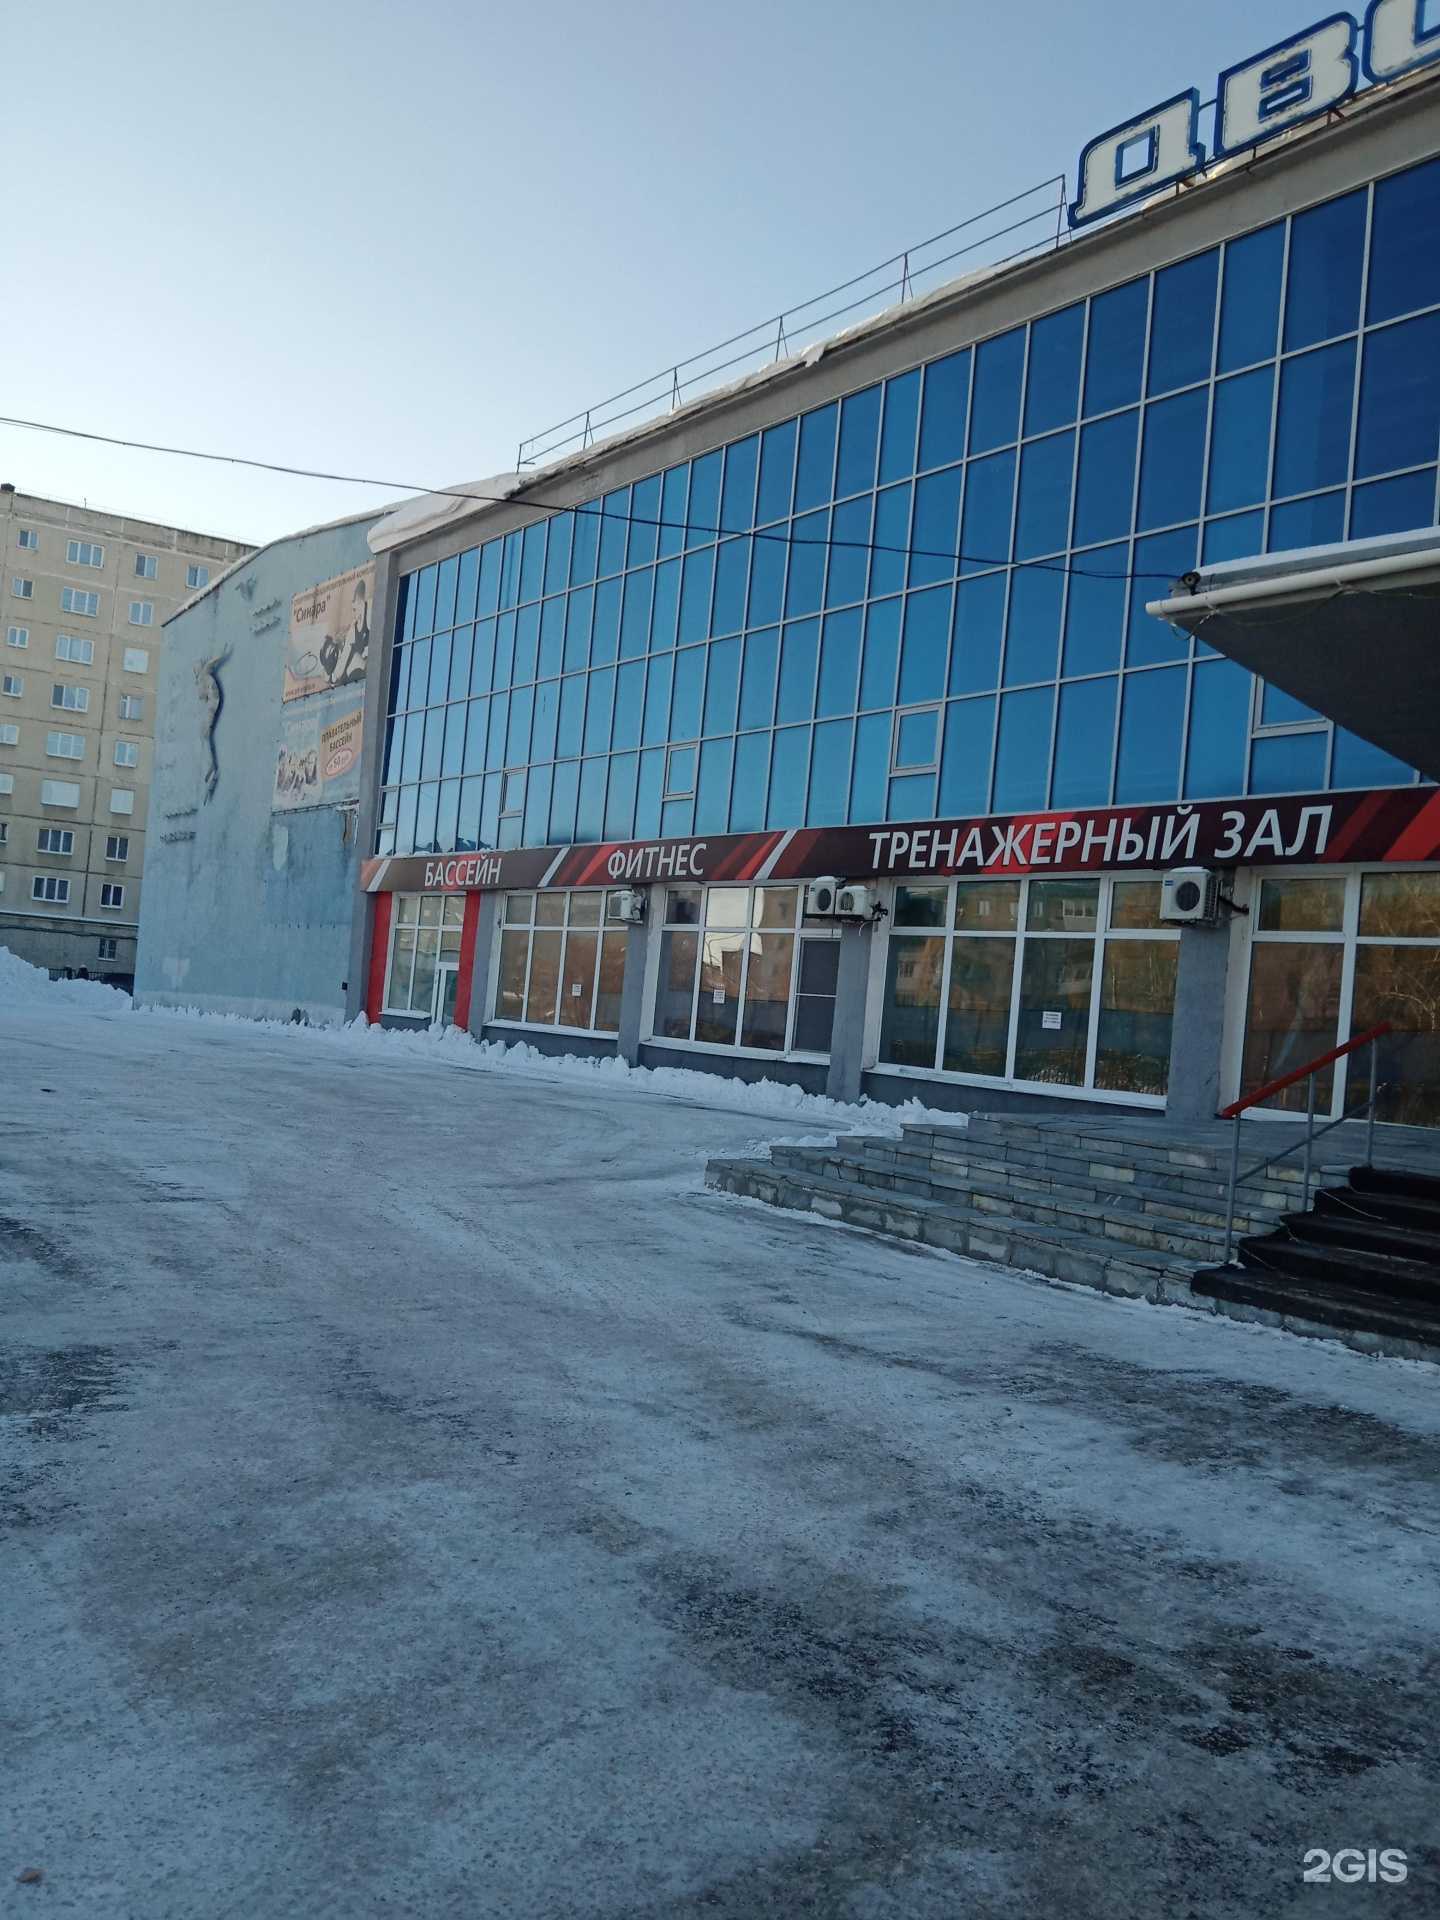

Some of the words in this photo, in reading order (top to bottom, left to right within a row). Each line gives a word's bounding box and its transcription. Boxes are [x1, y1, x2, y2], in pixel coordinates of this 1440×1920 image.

[868, 804, 1201, 870] ТРЕНАЖЕРНЫЙ
[1213, 804, 1334, 860] ЗАЛ
[424, 854, 502, 887] БАССЕЙН
[607, 843, 707, 880] ФИТНЕС
